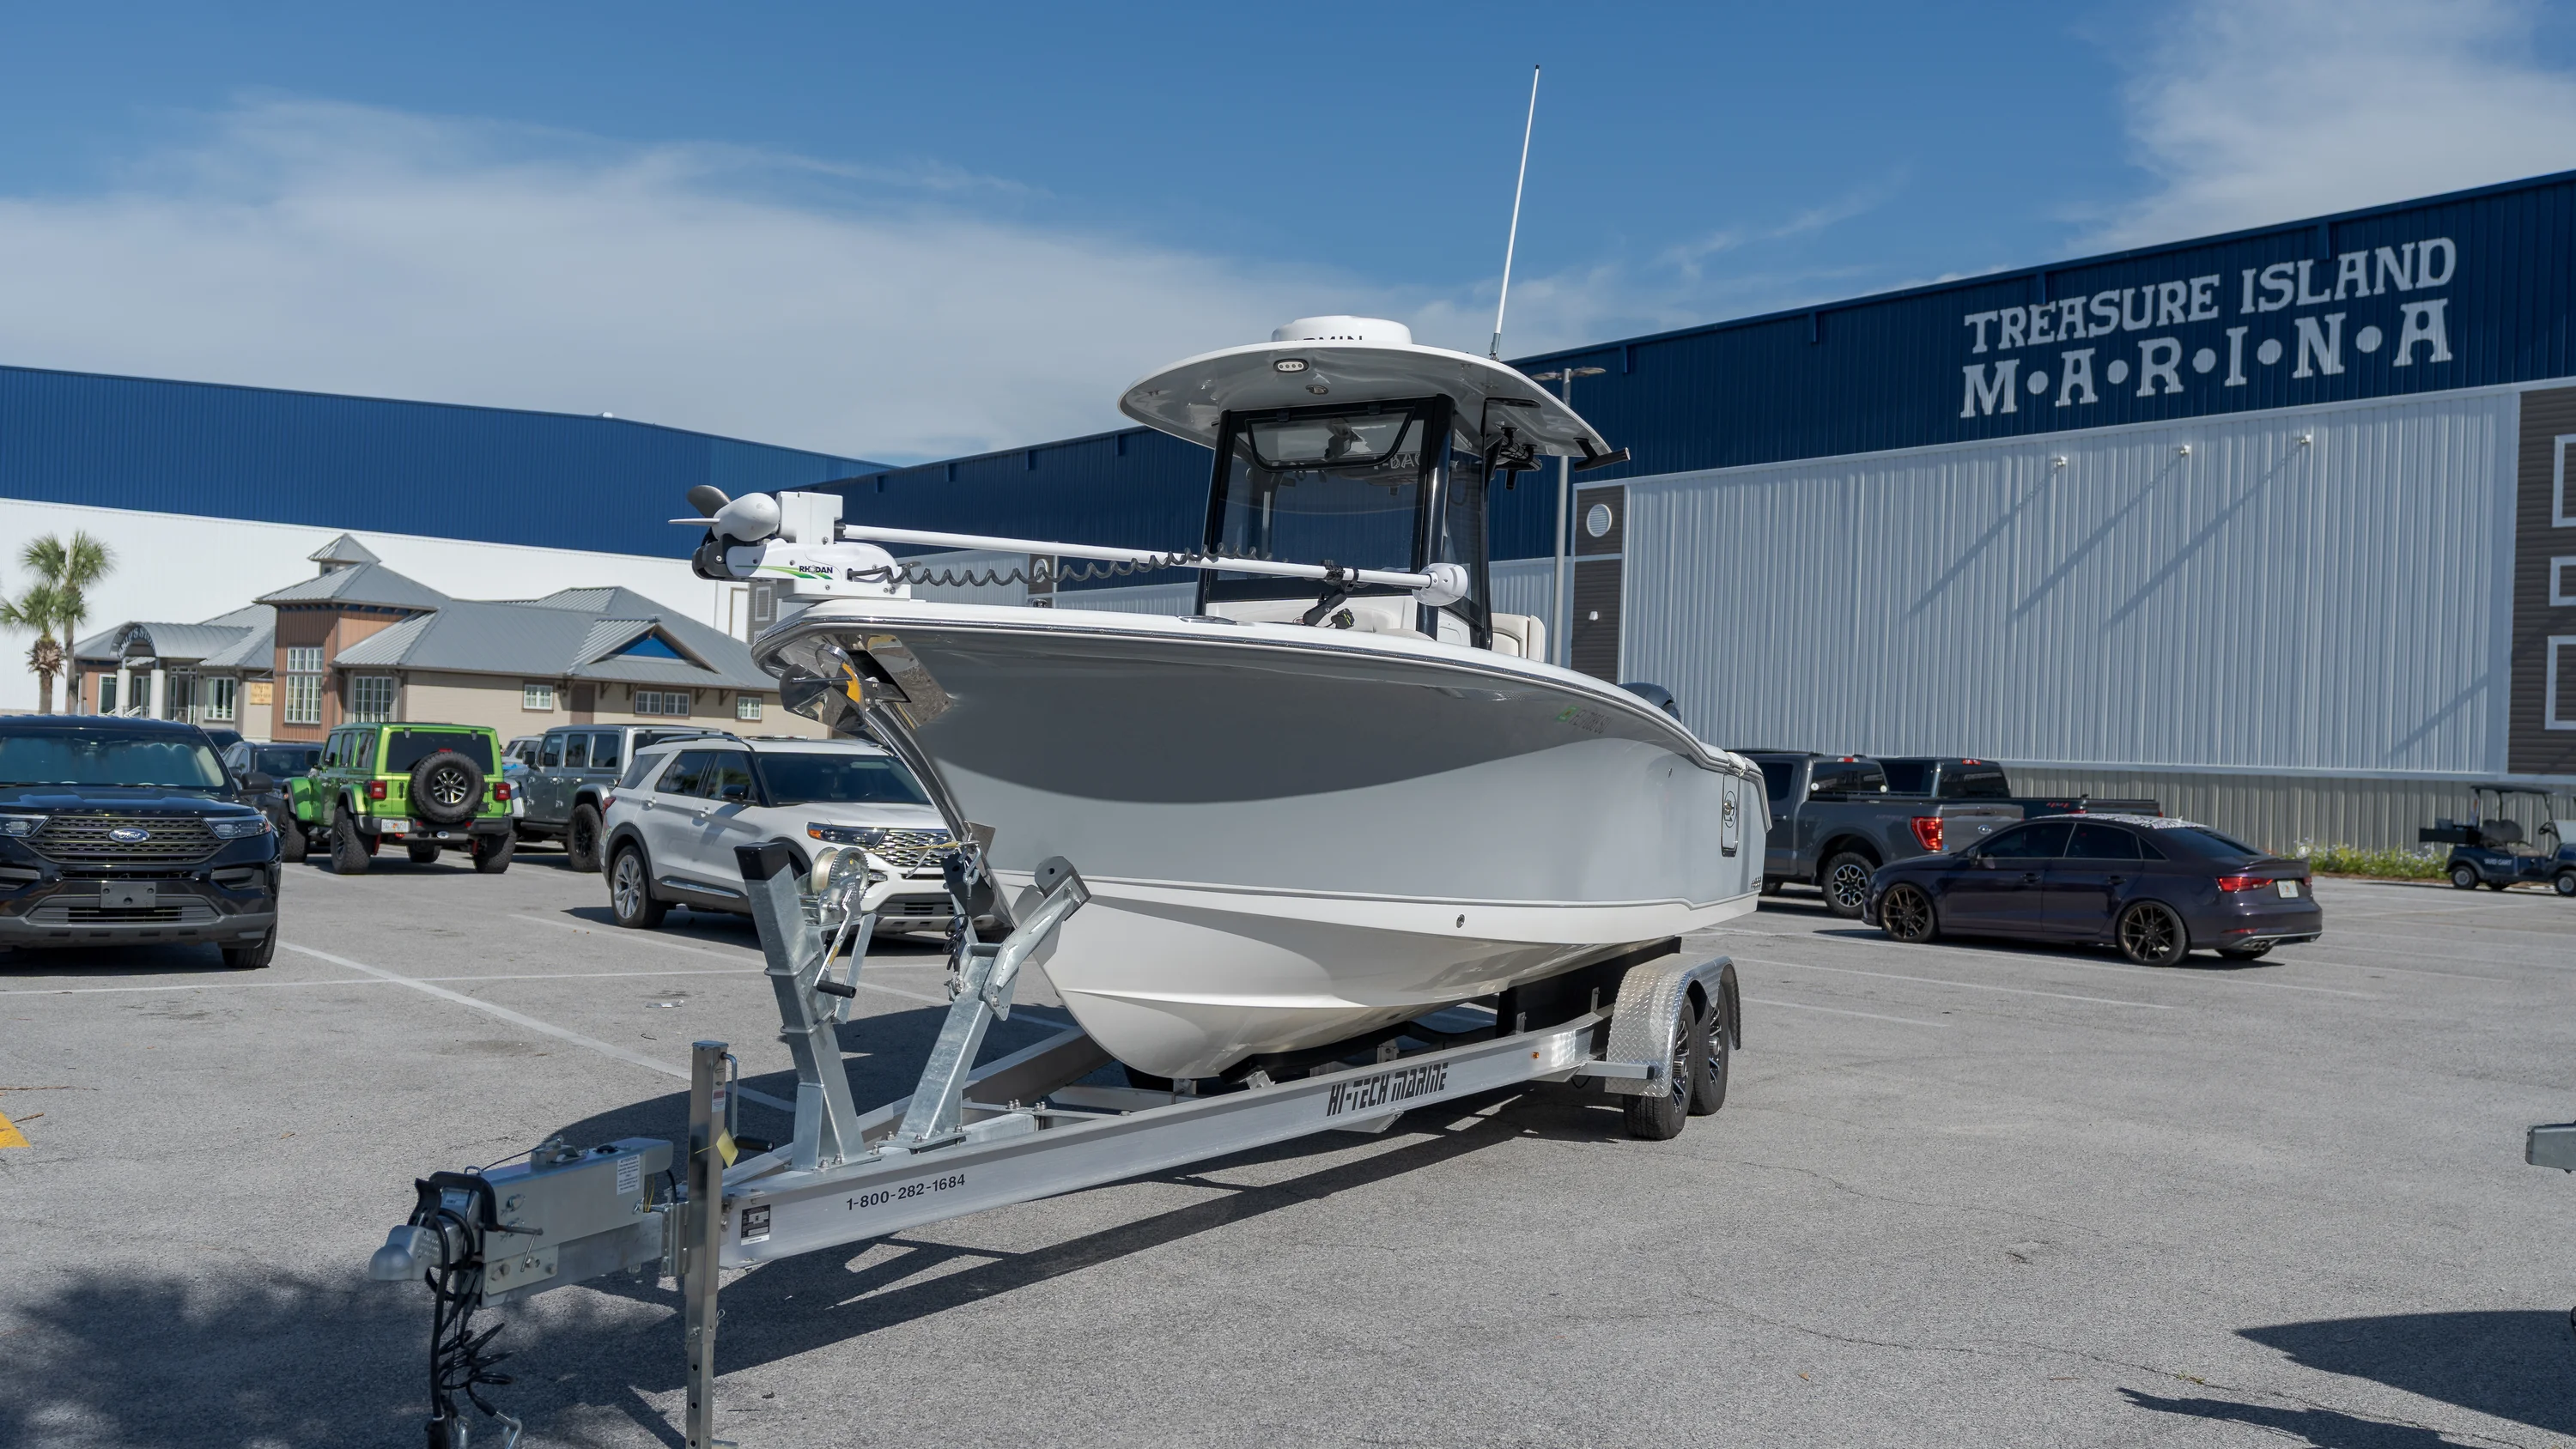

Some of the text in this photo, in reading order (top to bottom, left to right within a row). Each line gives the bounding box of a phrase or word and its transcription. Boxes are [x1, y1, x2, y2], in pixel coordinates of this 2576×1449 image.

[1964, 236, 2457, 354] TREASURE ISLAND
[799, 565, 833, 574] RHODAN
[1326, 1062, 1449, 1117] HI-TECH MARINE
[846, 1173, 966, 1211] 1-800-282-1684
